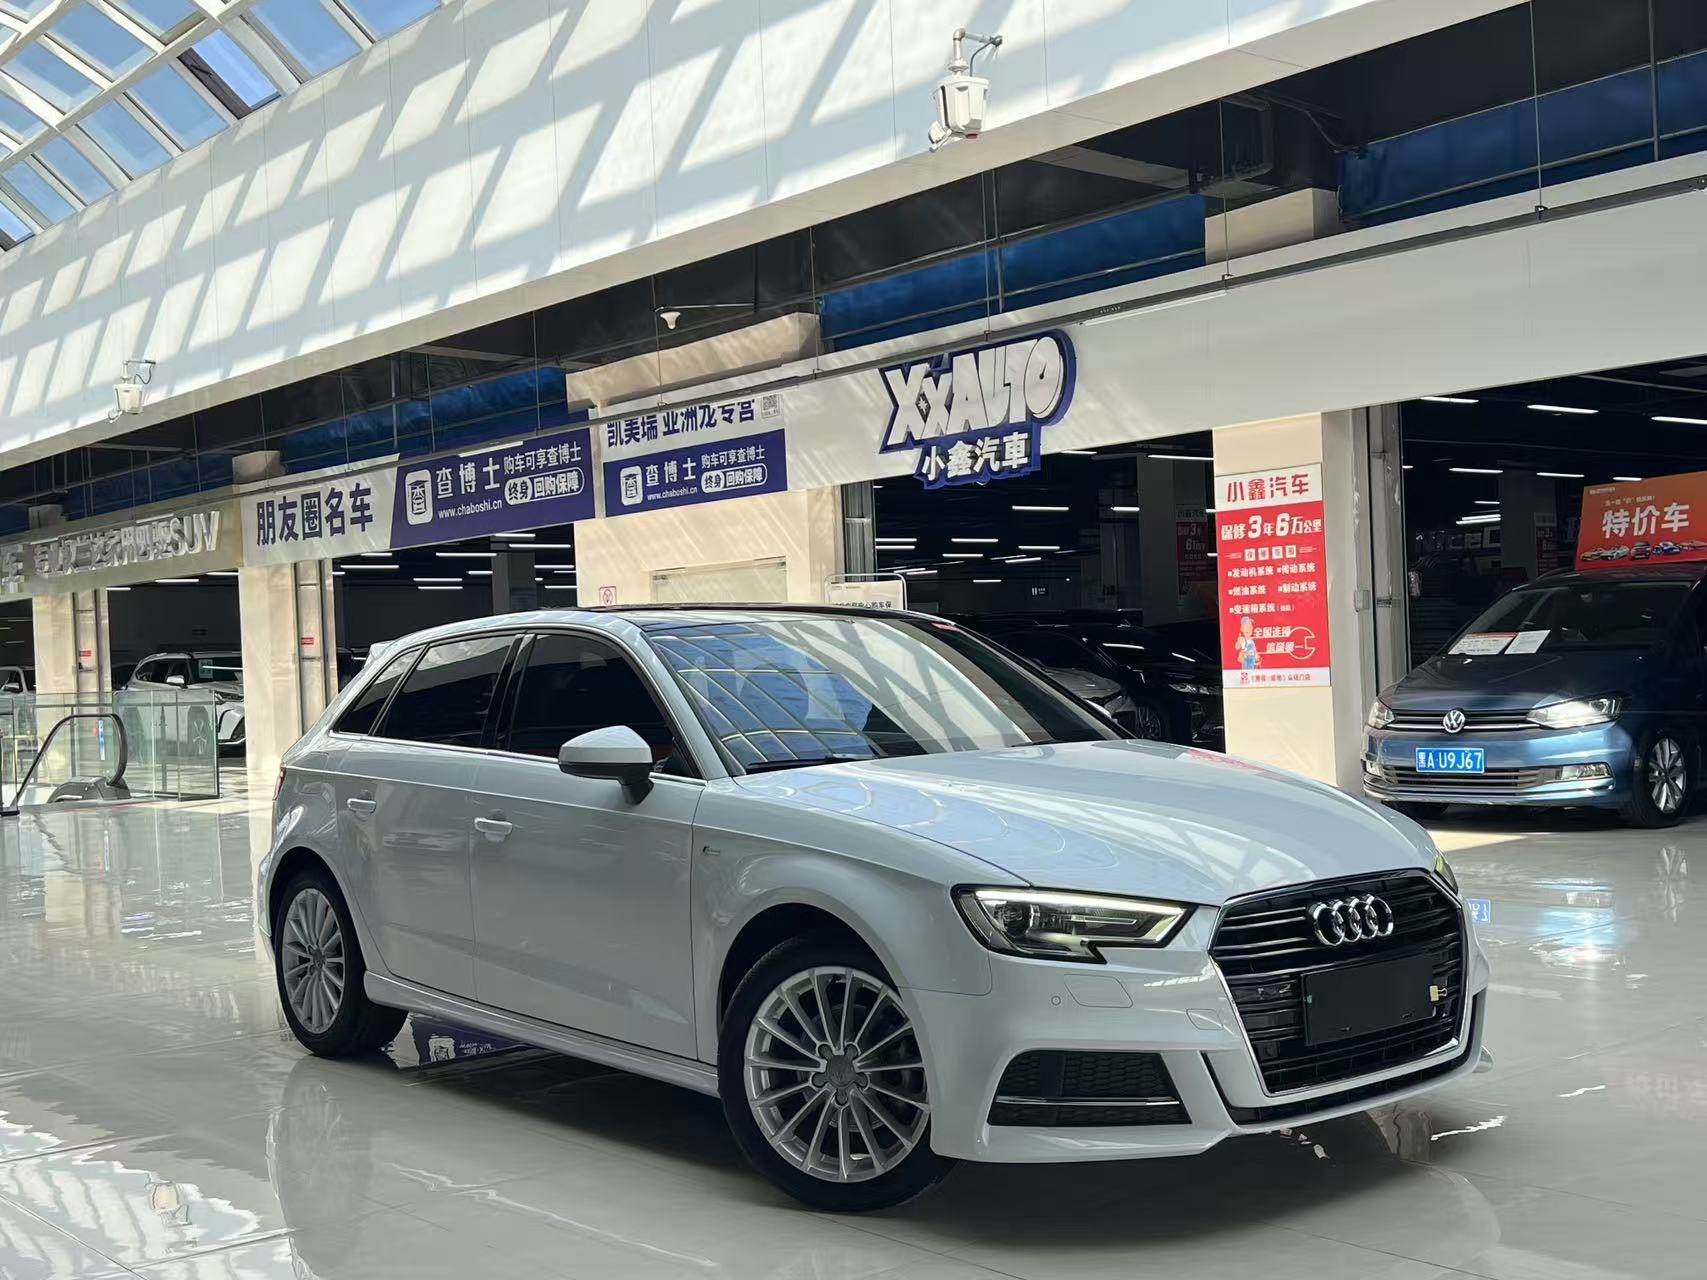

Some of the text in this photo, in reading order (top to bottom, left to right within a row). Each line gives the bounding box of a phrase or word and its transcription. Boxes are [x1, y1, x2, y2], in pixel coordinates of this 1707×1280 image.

[503, 441, 582, 475] 购车可享查博士
[701, 445, 766, 469] 购车可享查博士
[922, 431, 1029, 481] 小鑫汽車
[435, 457, 500, 499] 查博士
[508, 471, 579, 500] 终身 回购保障
[645, 457, 697, 487] 查博士
[704, 467, 763, 489] 终身 回购保障
[646, 486, 698, 501] www.chaboshi.cn
[1227, 473, 1309, 503] 小鑫汽车
[256, 482, 374, 546] 朋友圈名车
[438, 499, 503, 519] www.chaboshi.cn
[1601, 502, 1690, 539] 特价车
